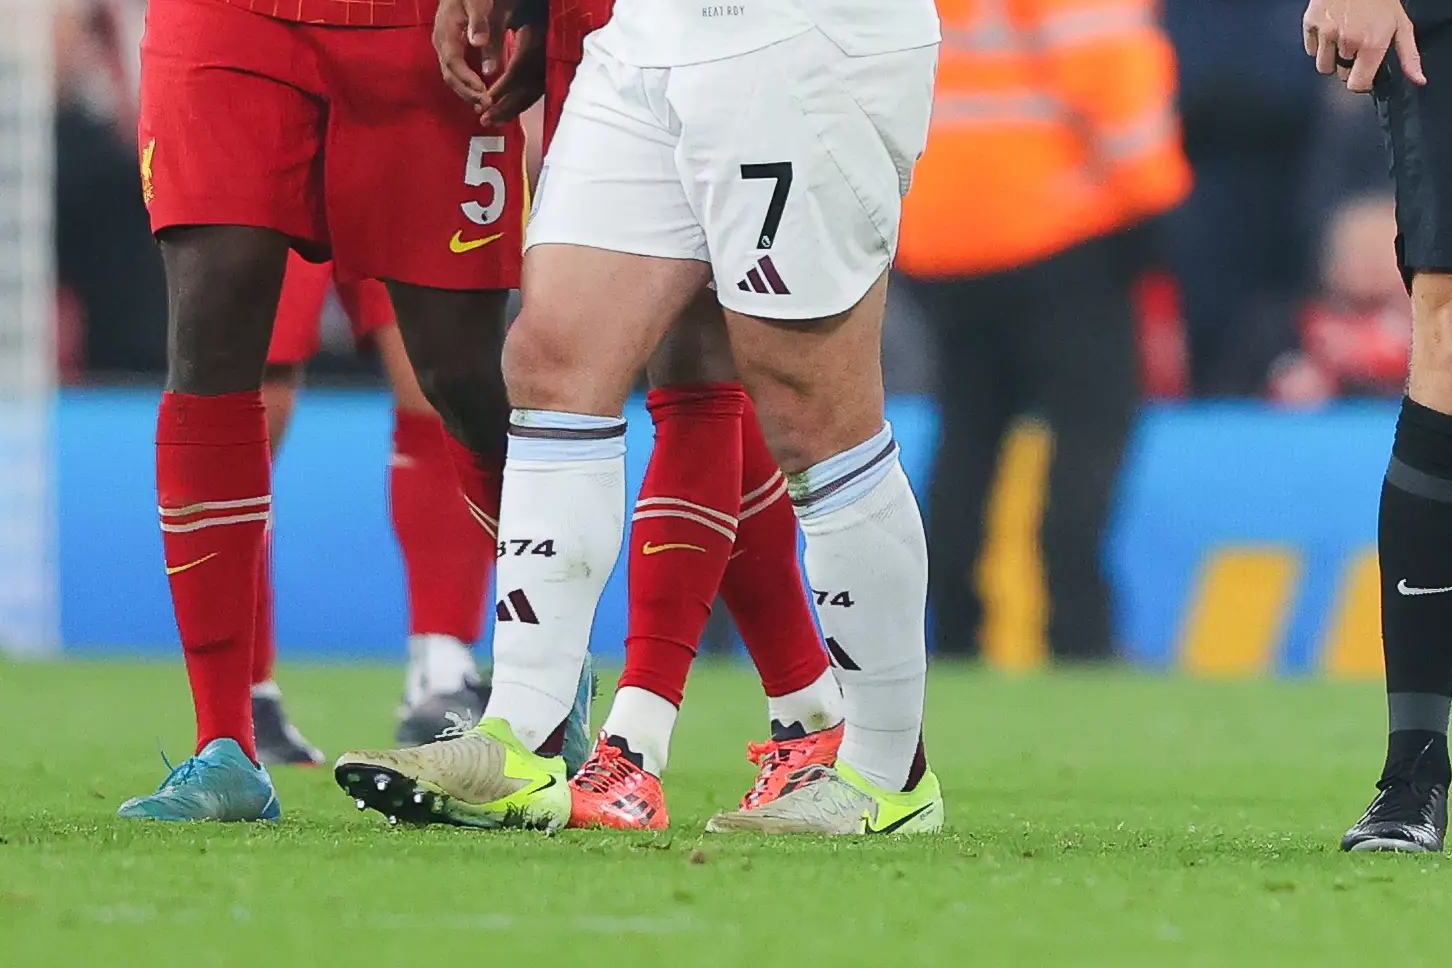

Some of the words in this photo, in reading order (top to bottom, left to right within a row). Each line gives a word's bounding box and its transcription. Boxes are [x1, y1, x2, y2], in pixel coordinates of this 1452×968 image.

[702, 6, 723, 17] HEAT
[460, 136, 507, 225] 5
[740, 161, 793, 250] 7
